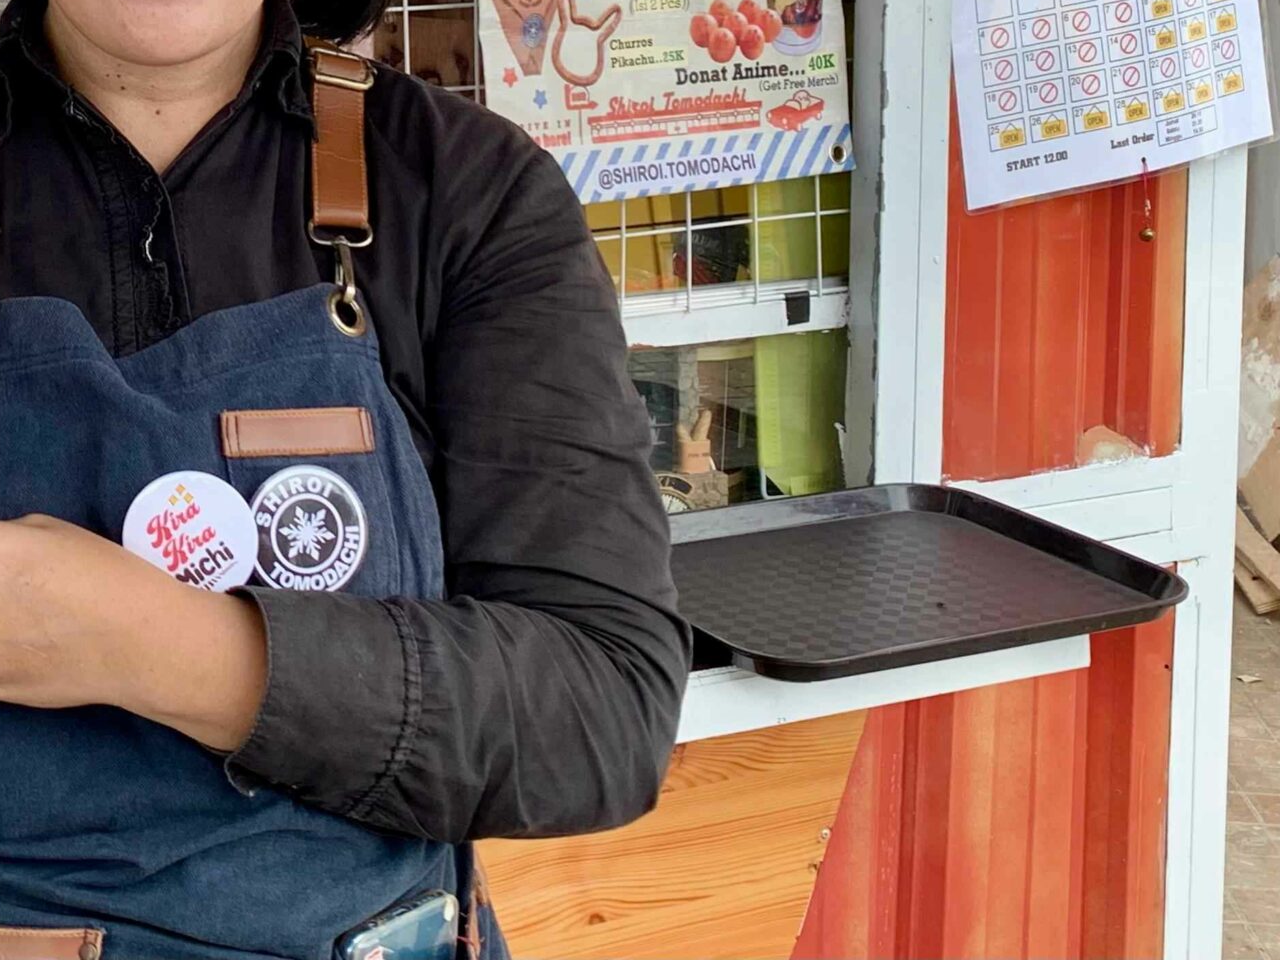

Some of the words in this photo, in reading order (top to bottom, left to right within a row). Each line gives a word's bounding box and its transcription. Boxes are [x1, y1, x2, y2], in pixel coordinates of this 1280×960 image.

[610, 37, 653, 52] Churros
[984, 62, 993, 71] 11
[1025, 53, 1035, 62] 12
[1068, 45, 1078, 54] 13
[1109, 36, 1119, 45] 14
[676, 65, 730, 87] Donat
[808, 53, 835, 72] 40K
[758, 77, 780, 92] (Get
[782, 75, 806, 90] Free
[807, 72, 839, 89] Merch)
[1070, 76, 1081, 86] 20
[662, 86, 747, 111] Tomodachi
[990, 126, 1000, 135] 25
[1031, 117, 1041, 127] 26
[1045, 125, 1061, 135] OPEN
[1074, 108, 1084, 118] 27
[1087, 116, 1104, 126] OPEN
[1116, 100, 1126, 109] 28
[1110, 138, 1130, 150] Last
[1132, 132, 1155, 146] Order
[598, 152, 757, 190] @SHIROI.TOMODACHI
[1006, 156, 1041, 173] START
[1044, 150, 1068, 165] 12.00
[255, 475, 333, 529] SHIROI
[146, 502, 201, 550] Kira
[162, 525, 217, 573] Kira
[175, 541, 235, 586] Michi
[270, 524, 361, 591] TOMODACHI
